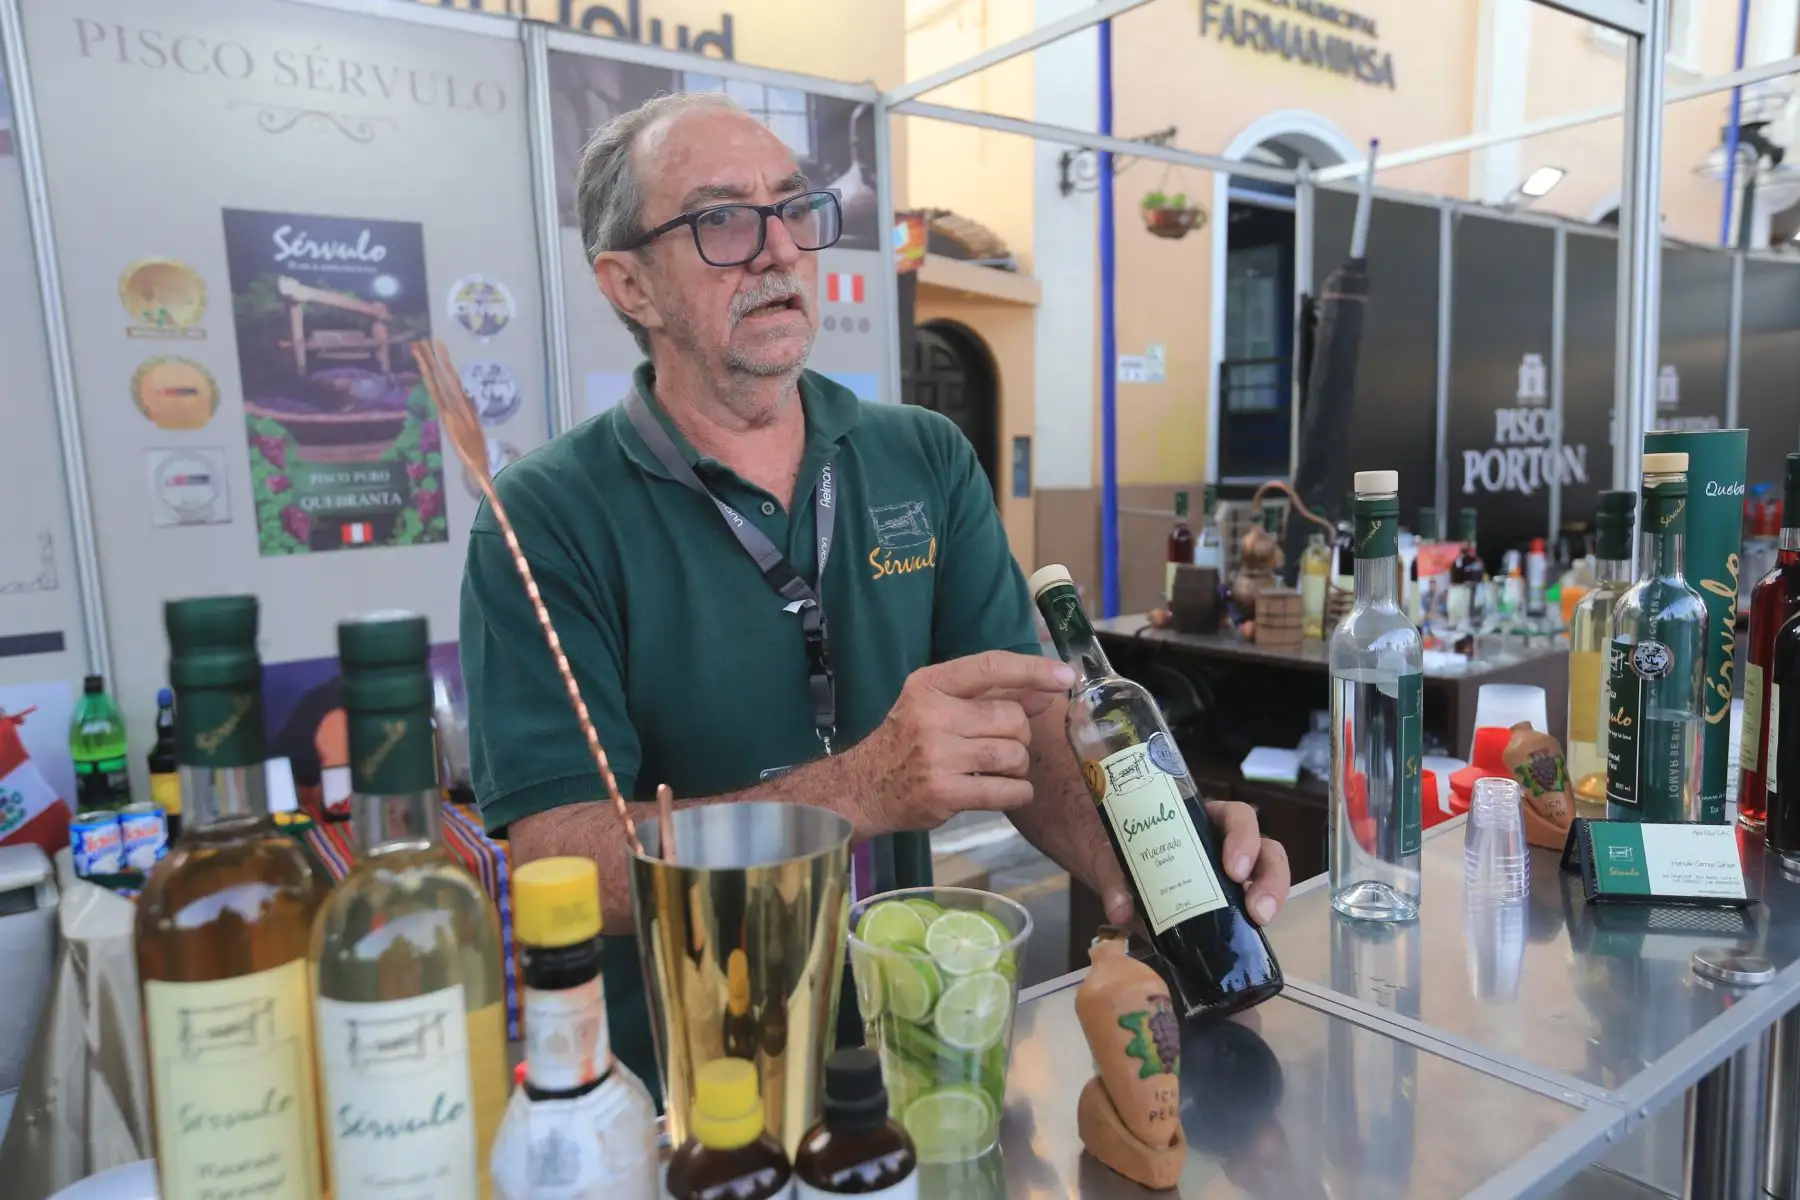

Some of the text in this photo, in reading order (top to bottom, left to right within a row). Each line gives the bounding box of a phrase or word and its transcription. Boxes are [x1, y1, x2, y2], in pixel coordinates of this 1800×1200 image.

[72, 17, 507, 115] PISCO SÉRVULO
[272, 224, 387, 262] Sérvulo
[299, 491, 403, 512] QUEBRANTA
[1123, 802, 1176, 843] Sérvulo
[1139, 837, 1182, 862] Macerado
[336, 1091, 466, 1139] Sérvulo
